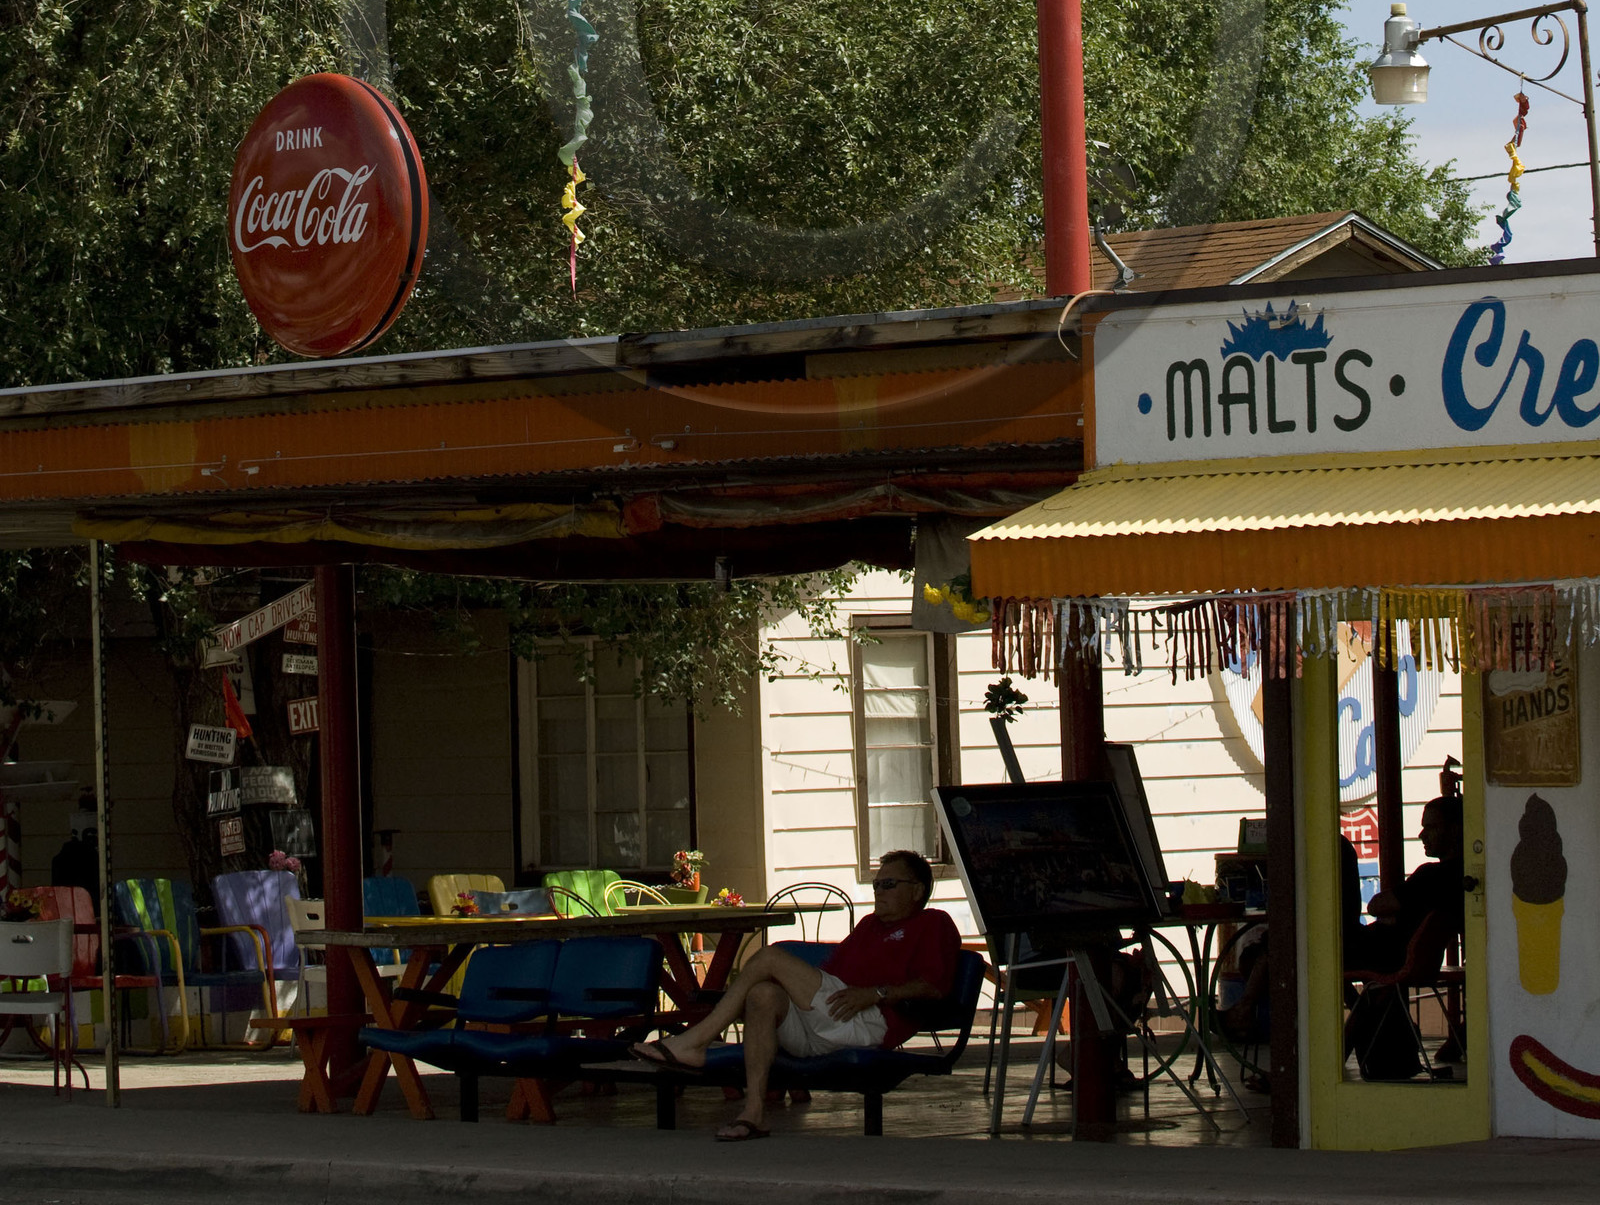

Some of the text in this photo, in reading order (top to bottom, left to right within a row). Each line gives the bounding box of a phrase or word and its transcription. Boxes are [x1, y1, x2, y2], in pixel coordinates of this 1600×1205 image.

[275, 126, 324, 152] DRINK
[234, 162, 378, 253] Coca-Cola
[1165, 348, 1373, 442] MALTS
[248, 611, 266, 639] CAP
[289, 699, 319, 732] EXIT
[1502, 683, 1570, 728] HANDS
[193, 728, 232, 745] HUNTING
